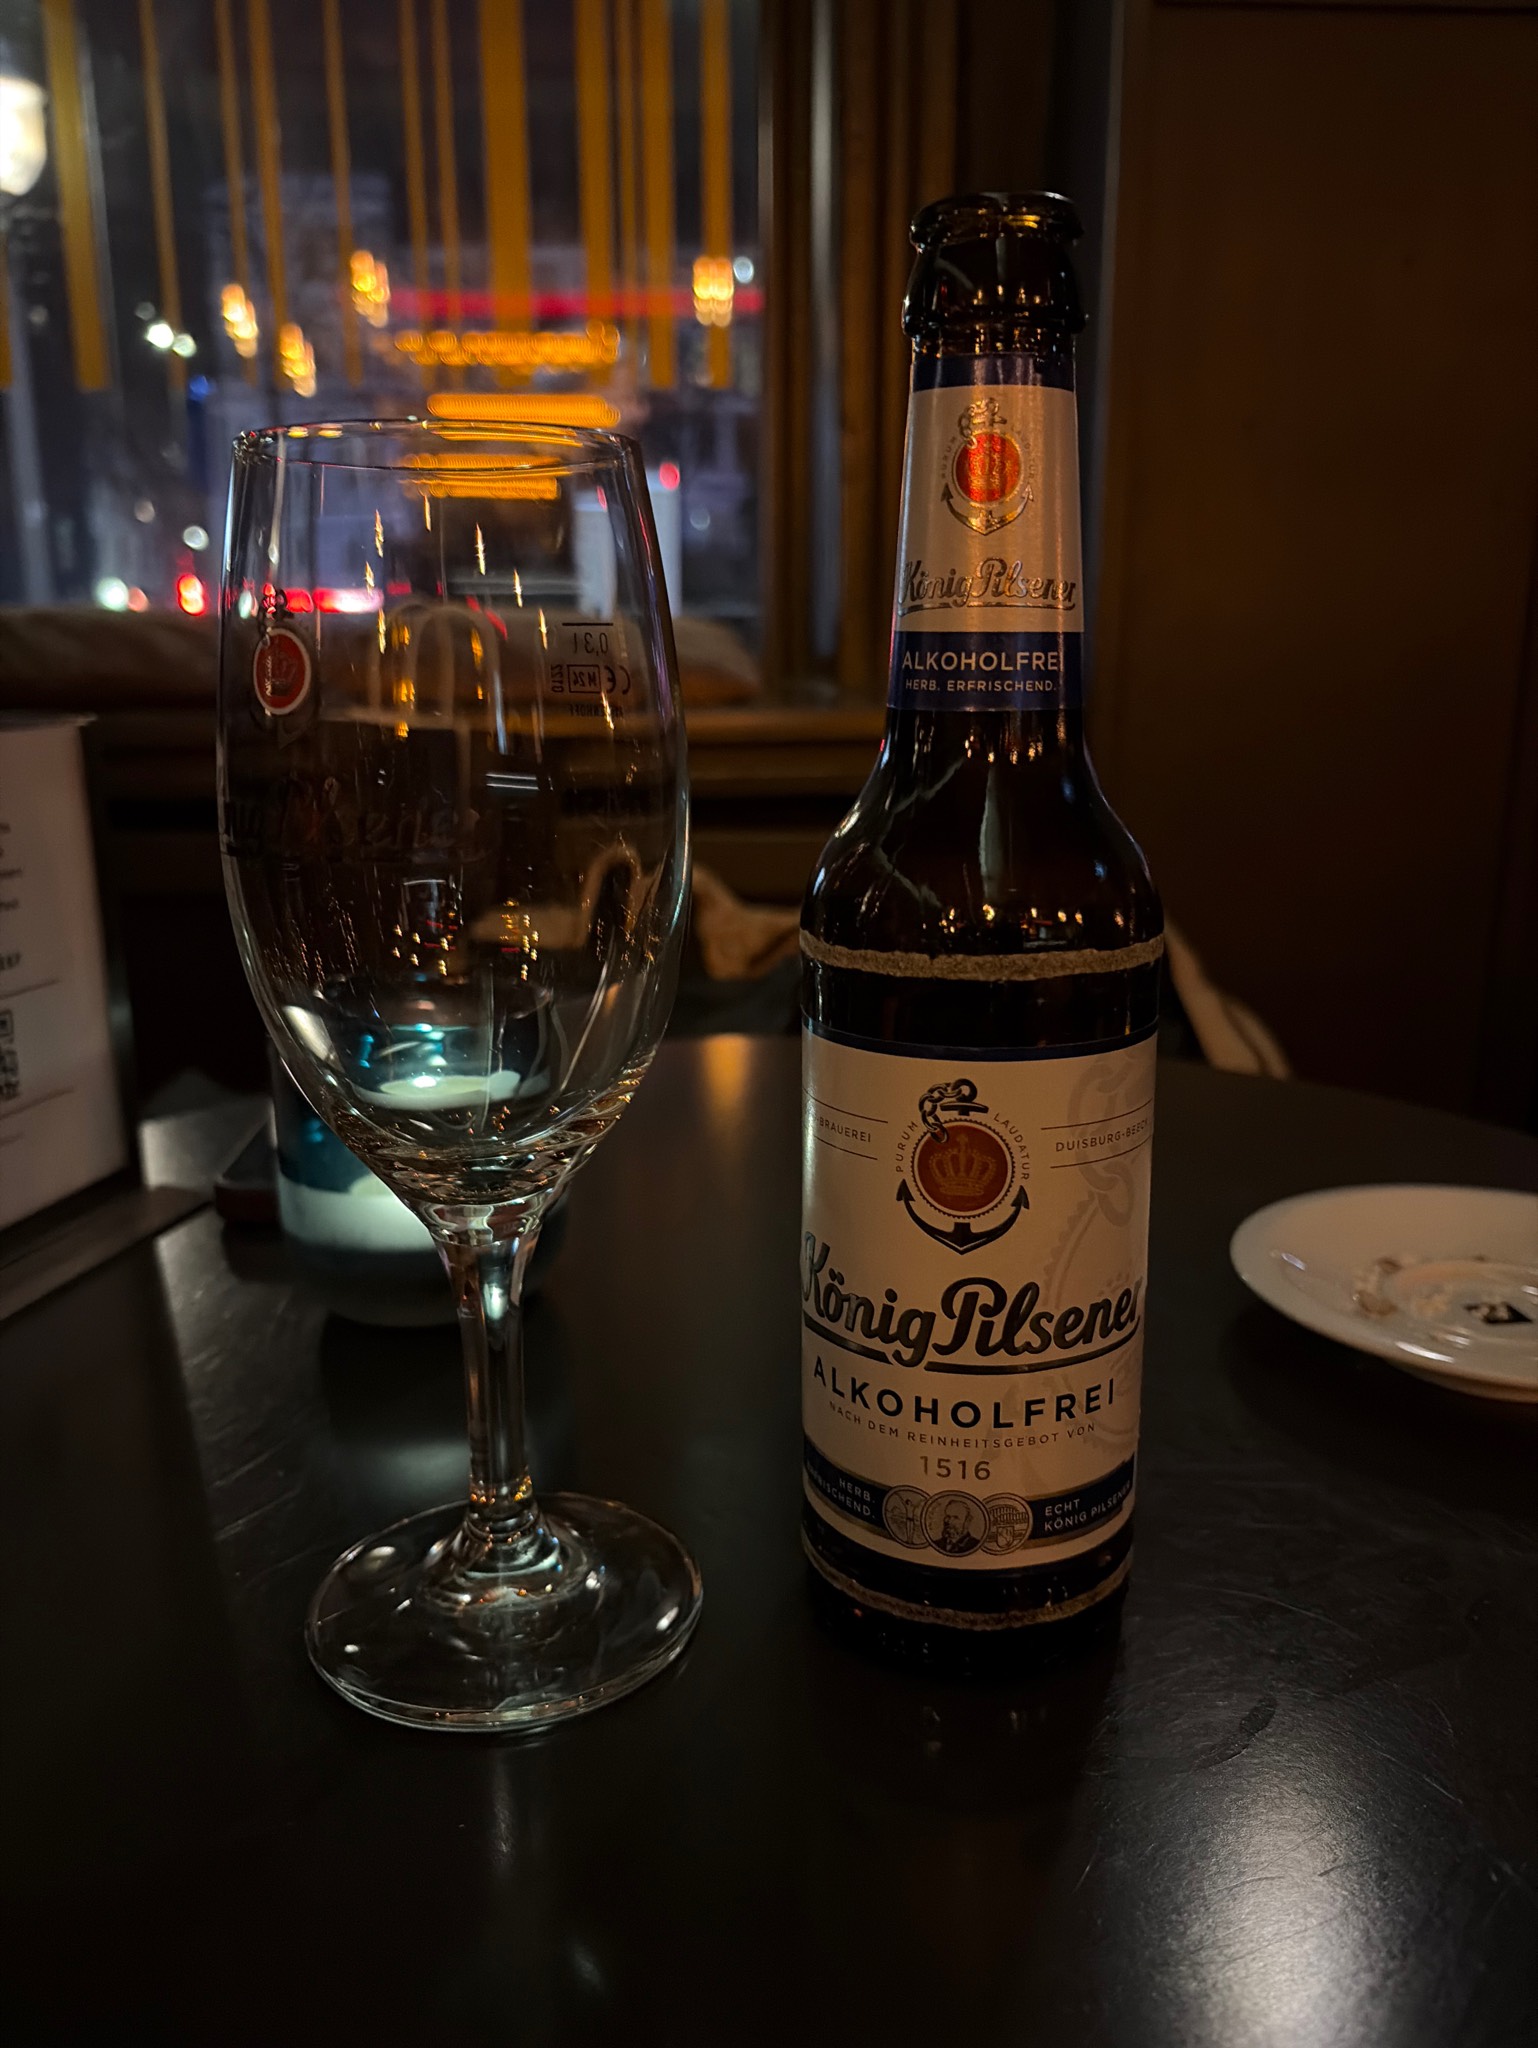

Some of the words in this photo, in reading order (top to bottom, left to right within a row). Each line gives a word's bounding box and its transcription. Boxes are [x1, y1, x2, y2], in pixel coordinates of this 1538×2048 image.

[900, 559, 974, 608] König
[971, 557, 1077, 602] Pilsener
[902, 650, 1065, 673] ALKOHOLFREI
[905, 678, 941, 692] HERB.
[946, 680, 1058, 692] ERFRISCHEND.
[895, 1120, 918, 1173] PURUM
[993, 1112, 1031, 1181] LAUDATUR
[801, 1231, 937, 1368] König
[931, 1276, 1143, 1357] Pilsener
[813, 1355, 1115, 1429] ALKOHOLFREI
[829, 1401, 861, 1425] NACH
[868, 1420, 900, 1438] DEM
[907, 1431, 1060, 1449] REINHEITSGEBOT
[1067, 1422, 1096, 1439] VON
[919, 1455, 992, 1481] 1516
[838, 1477, 876, 1504] HERB.
[1044, 1497, 1081, 1517] ECHT
[1043, 1511, 1088, 1533] KÖNIG
